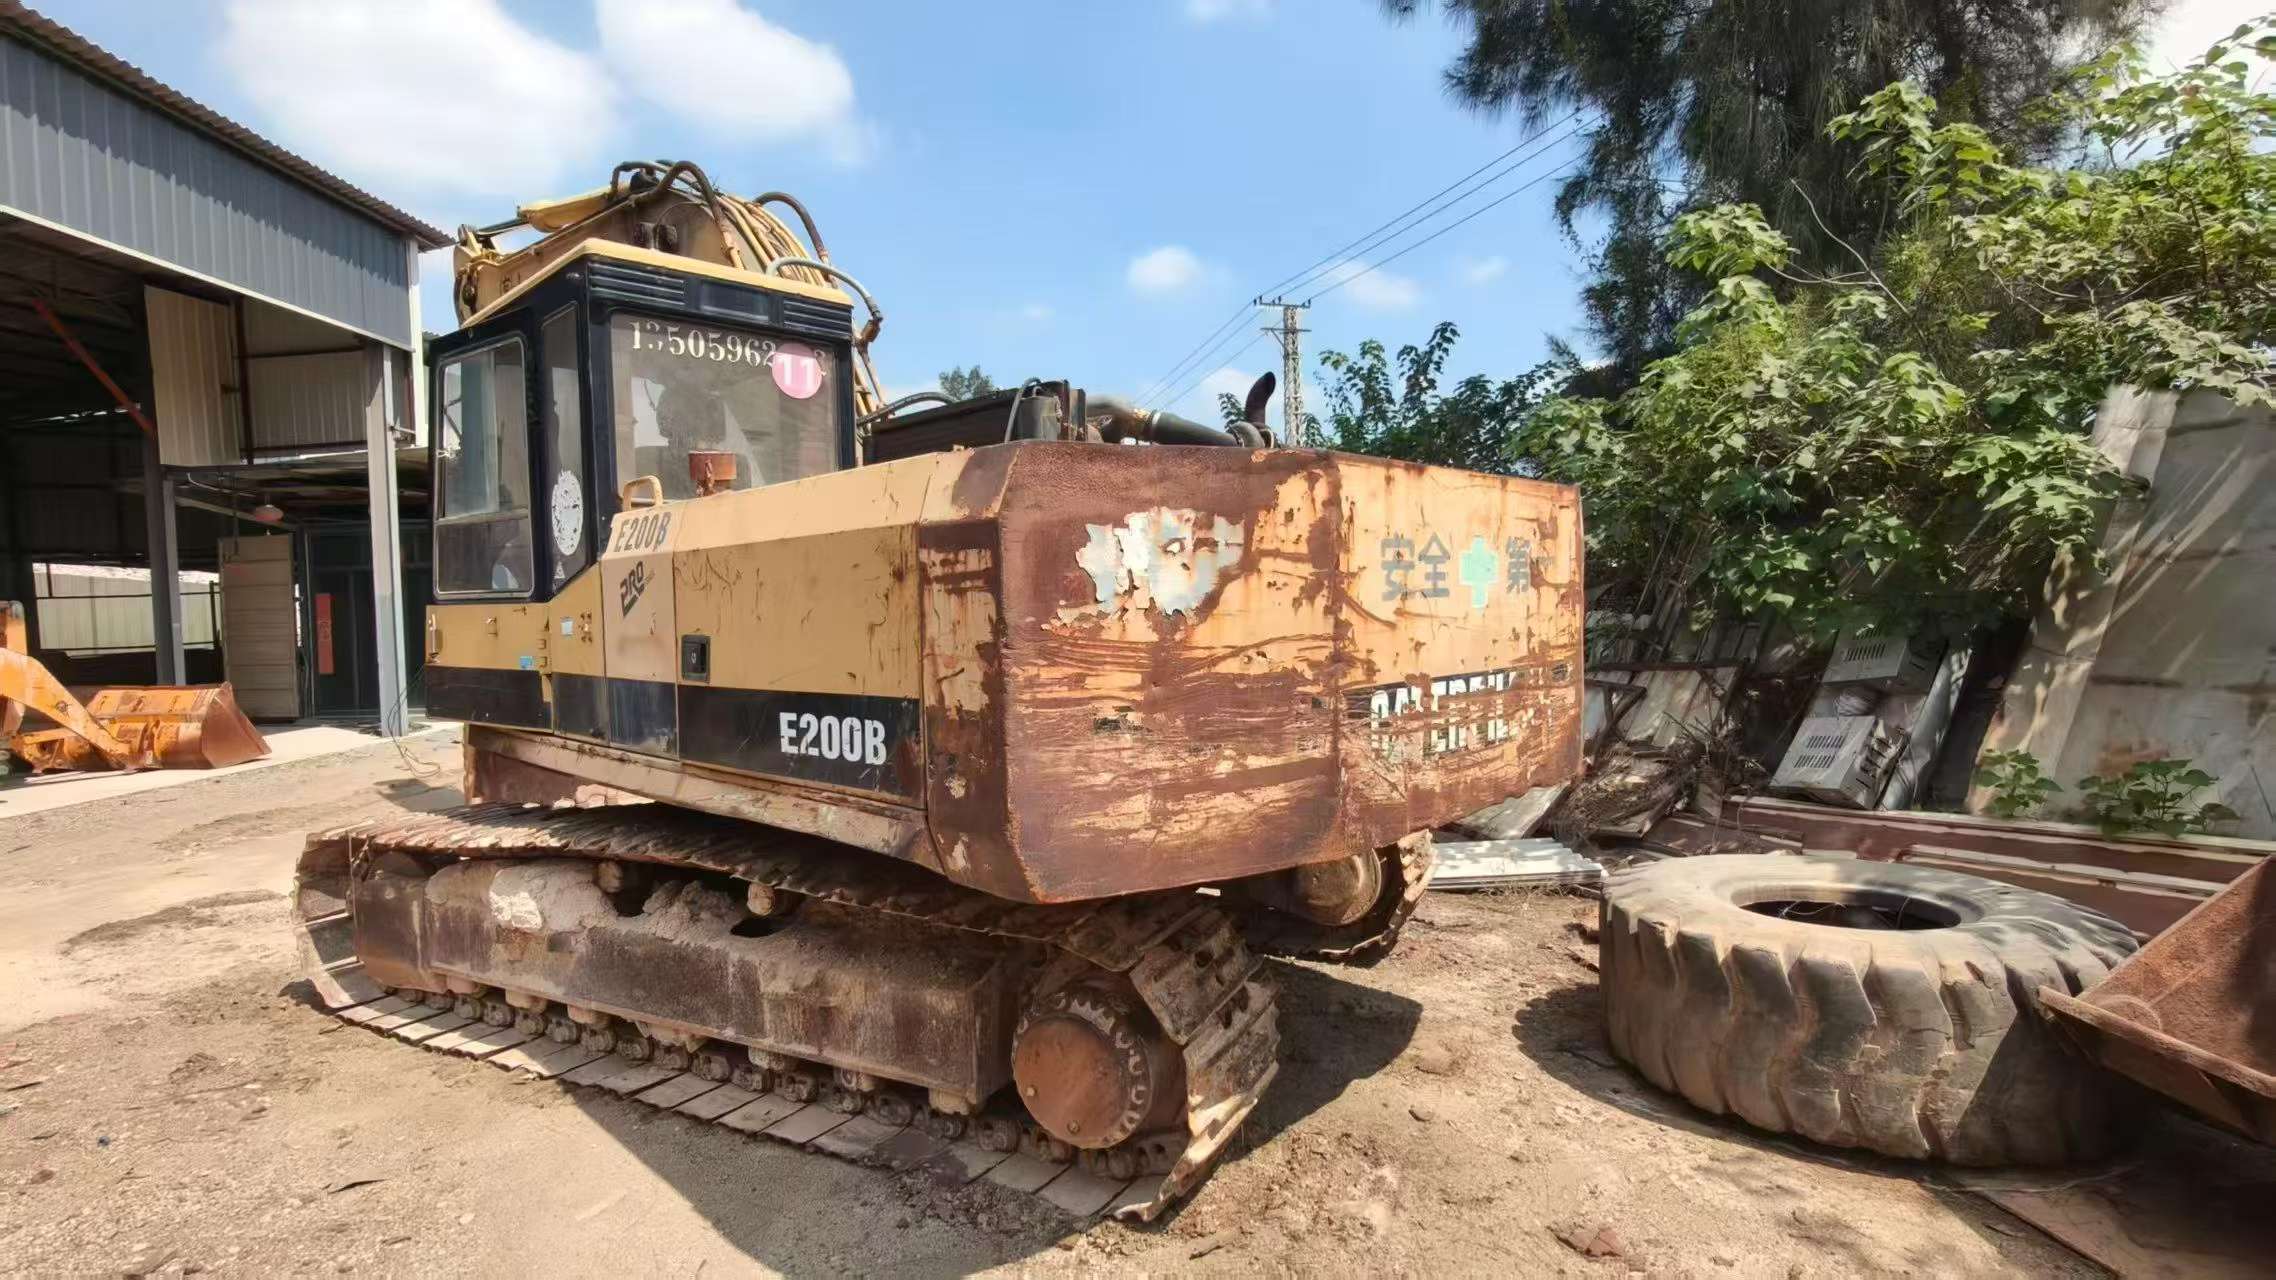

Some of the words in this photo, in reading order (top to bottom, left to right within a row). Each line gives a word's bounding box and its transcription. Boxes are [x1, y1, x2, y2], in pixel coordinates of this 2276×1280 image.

[630, 320, 826, 376] 13505962
[776, 354, 817, 390] 11
[614, 511, 672, 553] E200B
[1380, 531, 1450, 601] 安全
[779, 711, 888, 766] E200B
